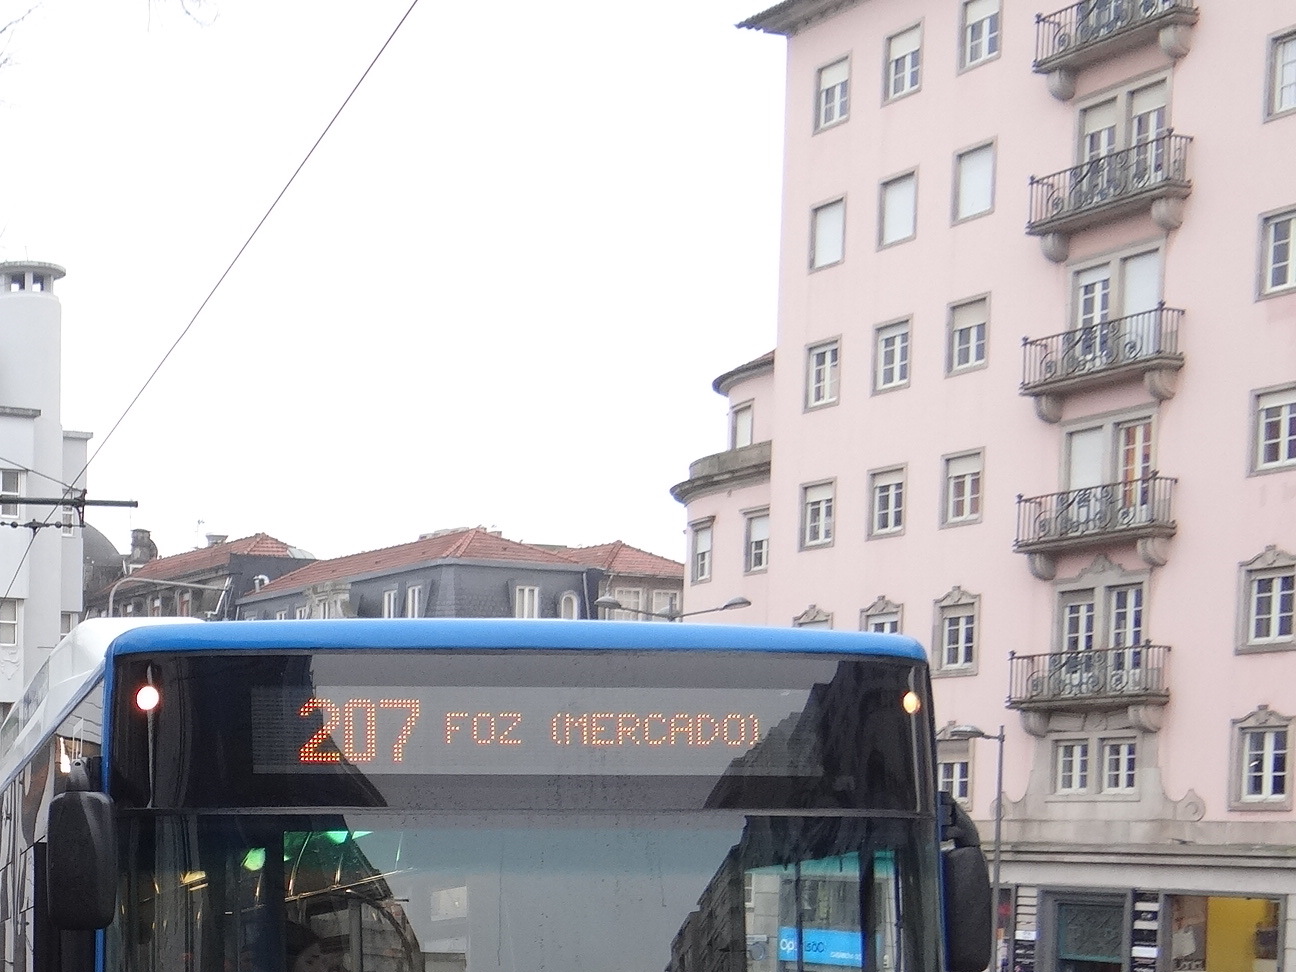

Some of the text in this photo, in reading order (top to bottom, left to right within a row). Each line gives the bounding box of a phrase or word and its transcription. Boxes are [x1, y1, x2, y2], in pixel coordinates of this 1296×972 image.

[298, 698, 760, 763] 207 FOZ (MERCADO)
